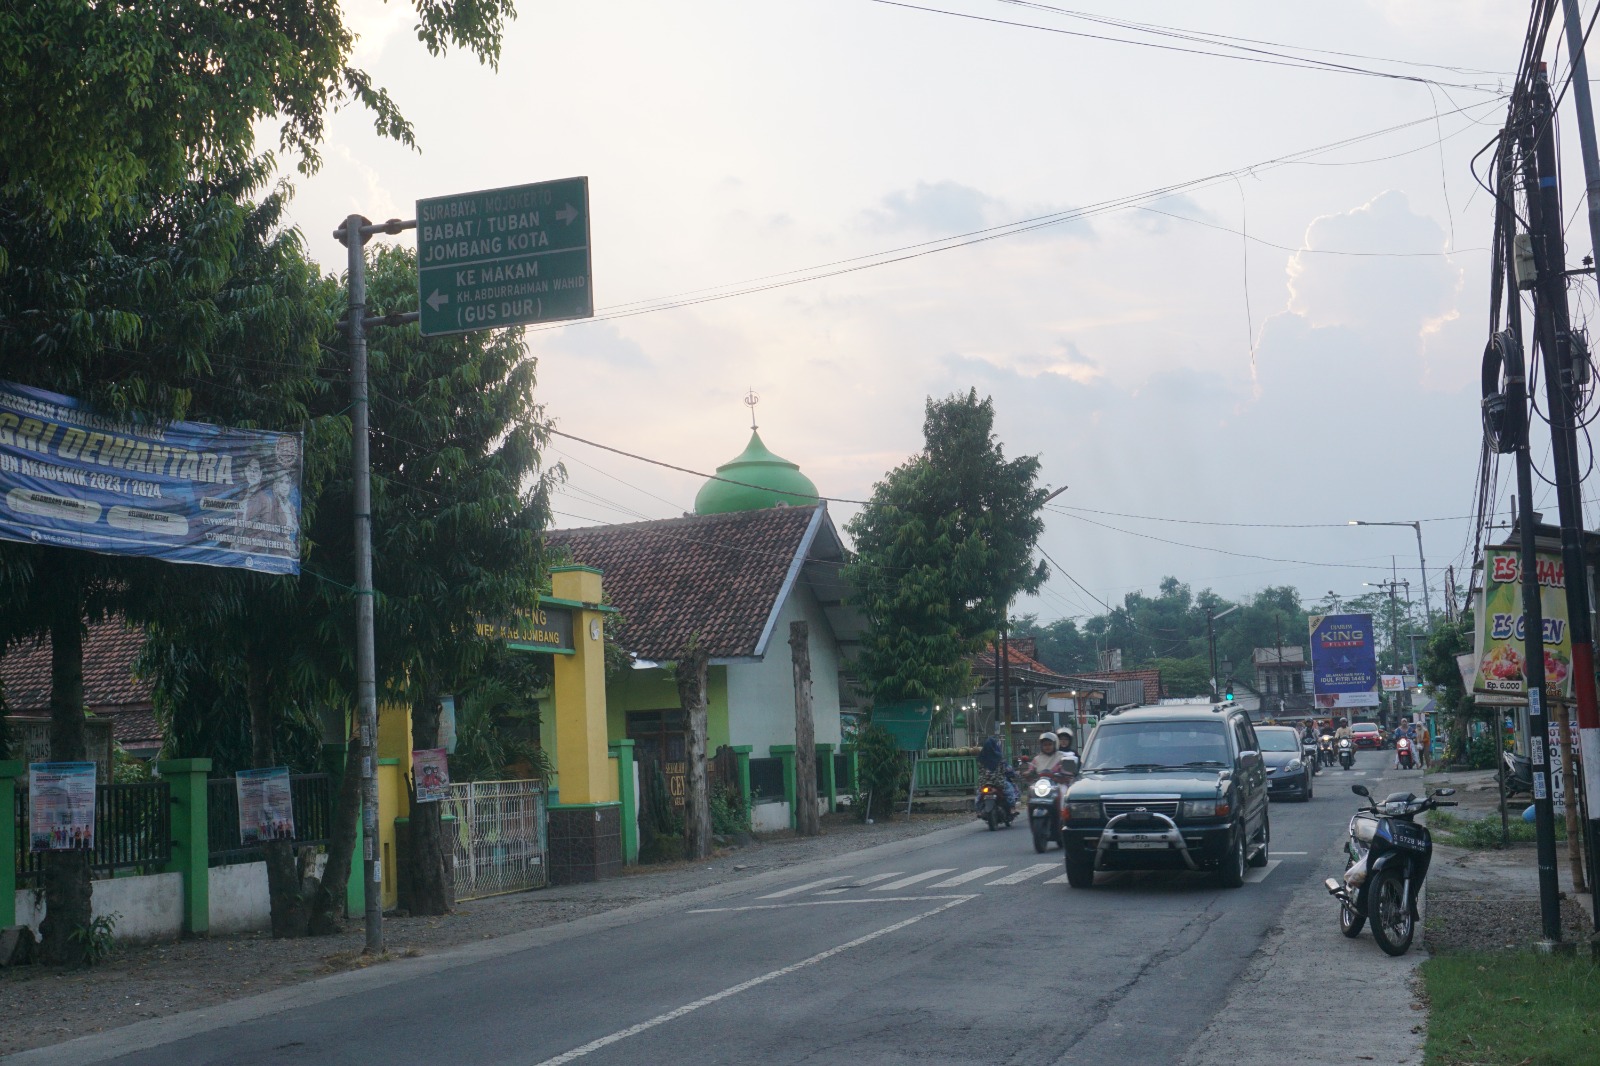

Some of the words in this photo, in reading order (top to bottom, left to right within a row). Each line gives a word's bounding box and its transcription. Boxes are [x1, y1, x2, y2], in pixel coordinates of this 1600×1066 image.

[423, 200, 477, 222] SURABAYA
[486, 189, 552, 213] MOJOKERTO
[487, 211, 540, 233] TUBAN
[425, 237, 501, 262] JOMBANG
[508, 231, 548, 250] KOTA
[456, 270, 476, 286] KE
[482, 261, 538, 283] MAKAM
[475, 280, 548, 300] ABDURRAHMAN
[553, 276, 585, 290] WAHID
[58, 427, 234, 485] DEWANTARA
[21, 458, 88, 486] AKADEMIK
[90, 472, 122, 493] 2023
[132, 480, 162, 499] 2024
[1494, 558, 1517, 581] ES
[1311, 617, 1320, 628] NEW
[1493, 615, 1513, 638] ES
[1320, 630, 1364, 641] KING
[1486, 682, 1498, 691] Rp.
